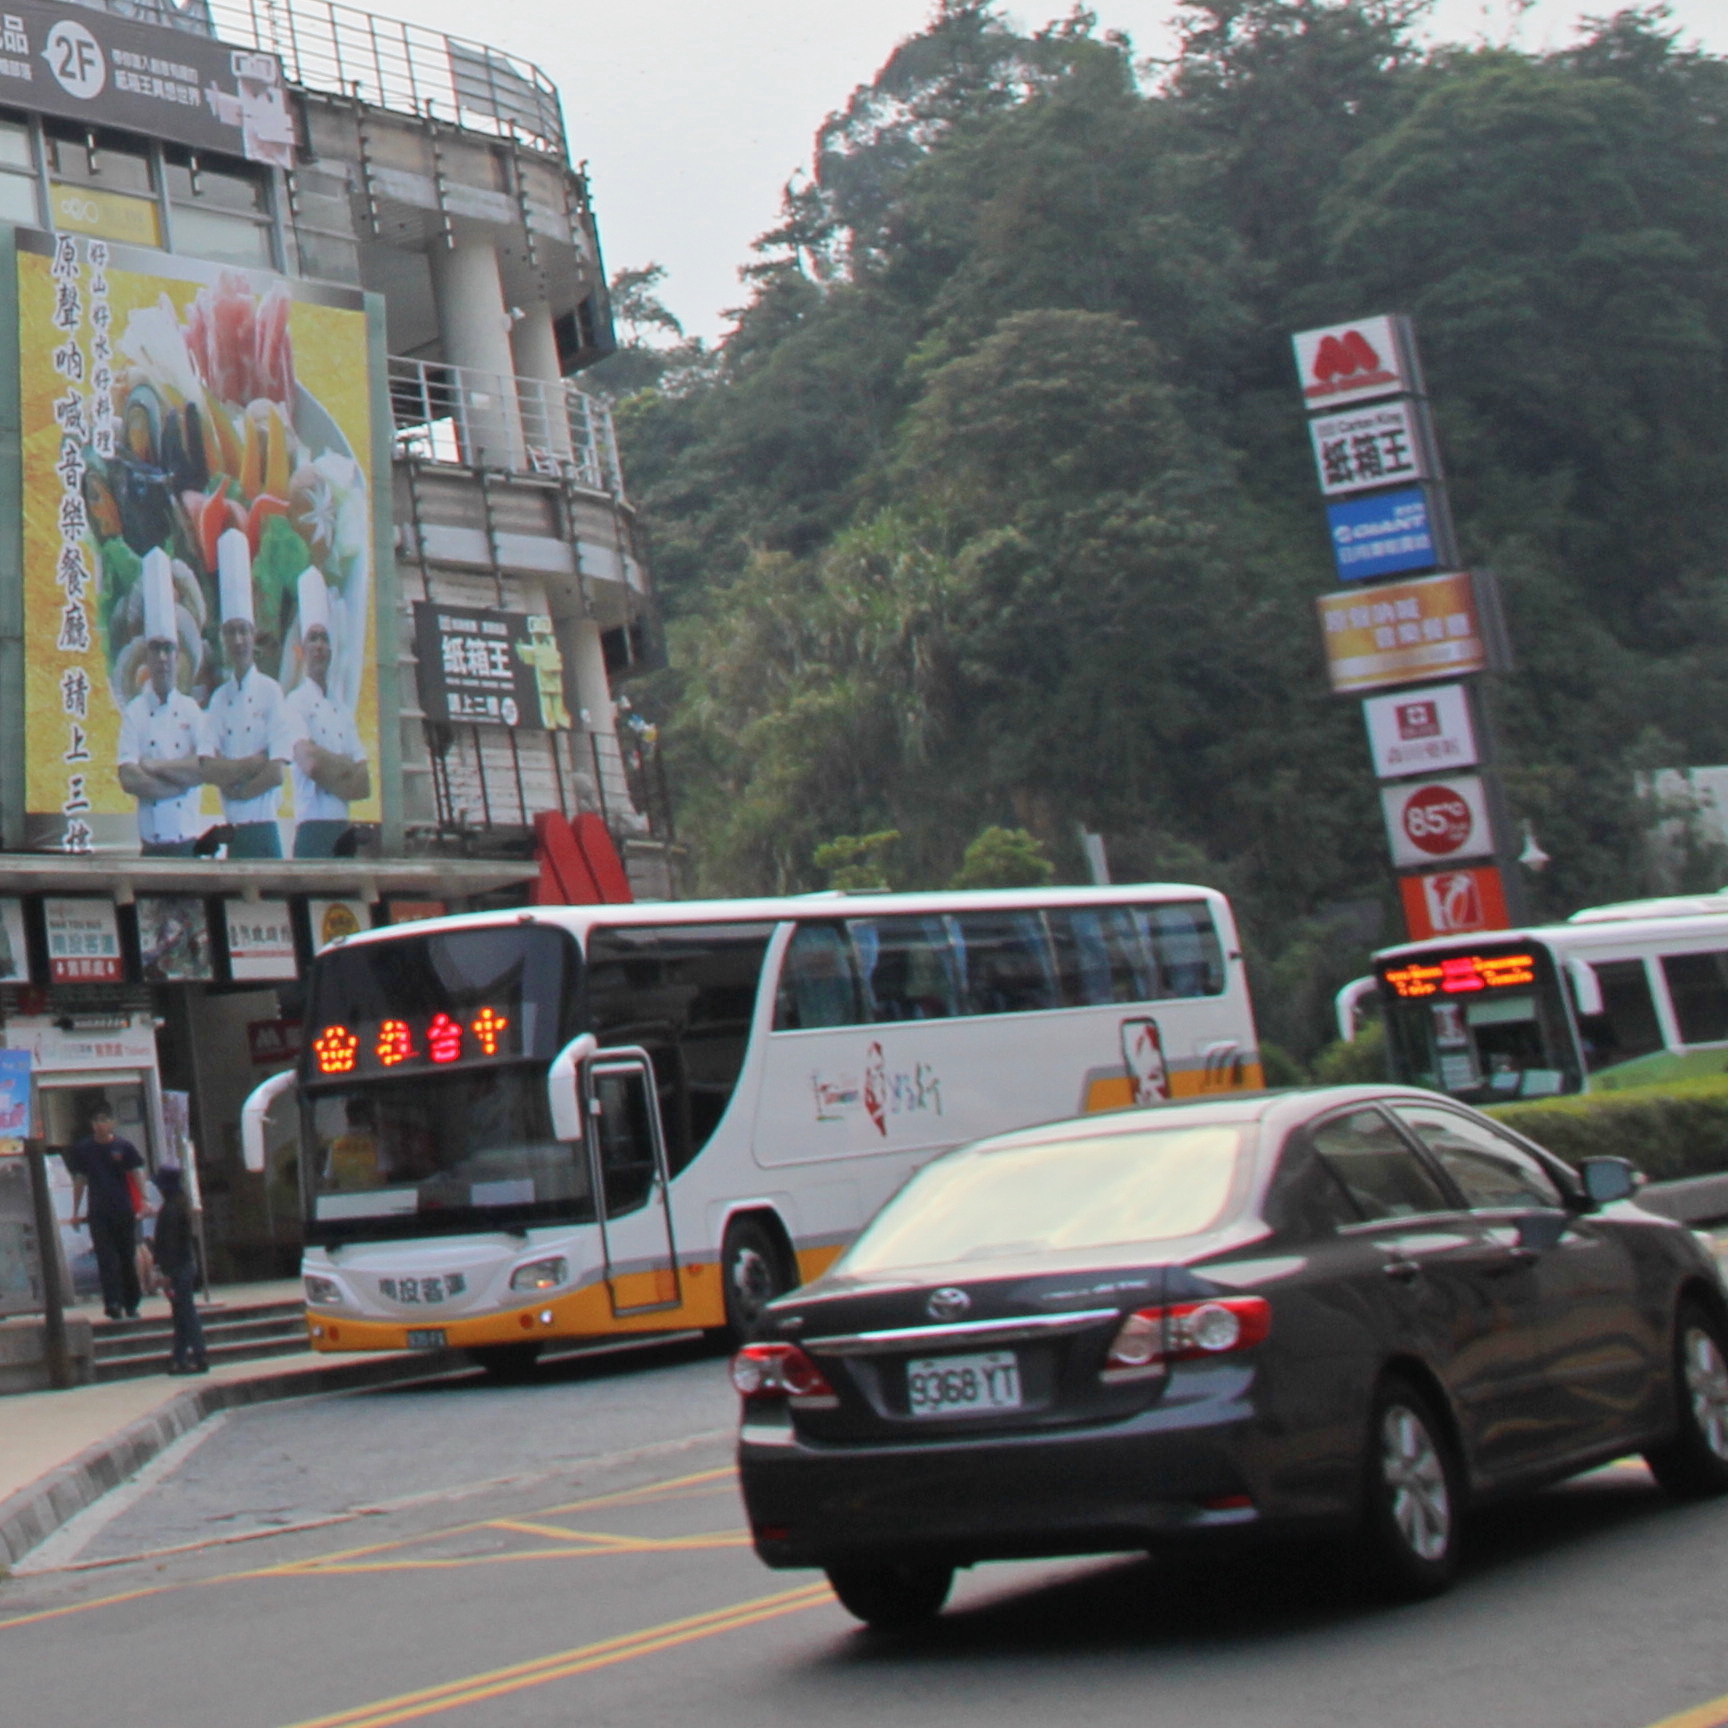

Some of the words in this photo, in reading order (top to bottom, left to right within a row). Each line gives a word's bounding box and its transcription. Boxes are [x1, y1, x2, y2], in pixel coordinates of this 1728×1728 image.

[55, 35, 95, 82] 2F
[89, 240, 113, 457] 好山好水好料理
[1322, 428, 1415, 485] 紙箱王
[441, 635, 514, 678] 紙箱王
